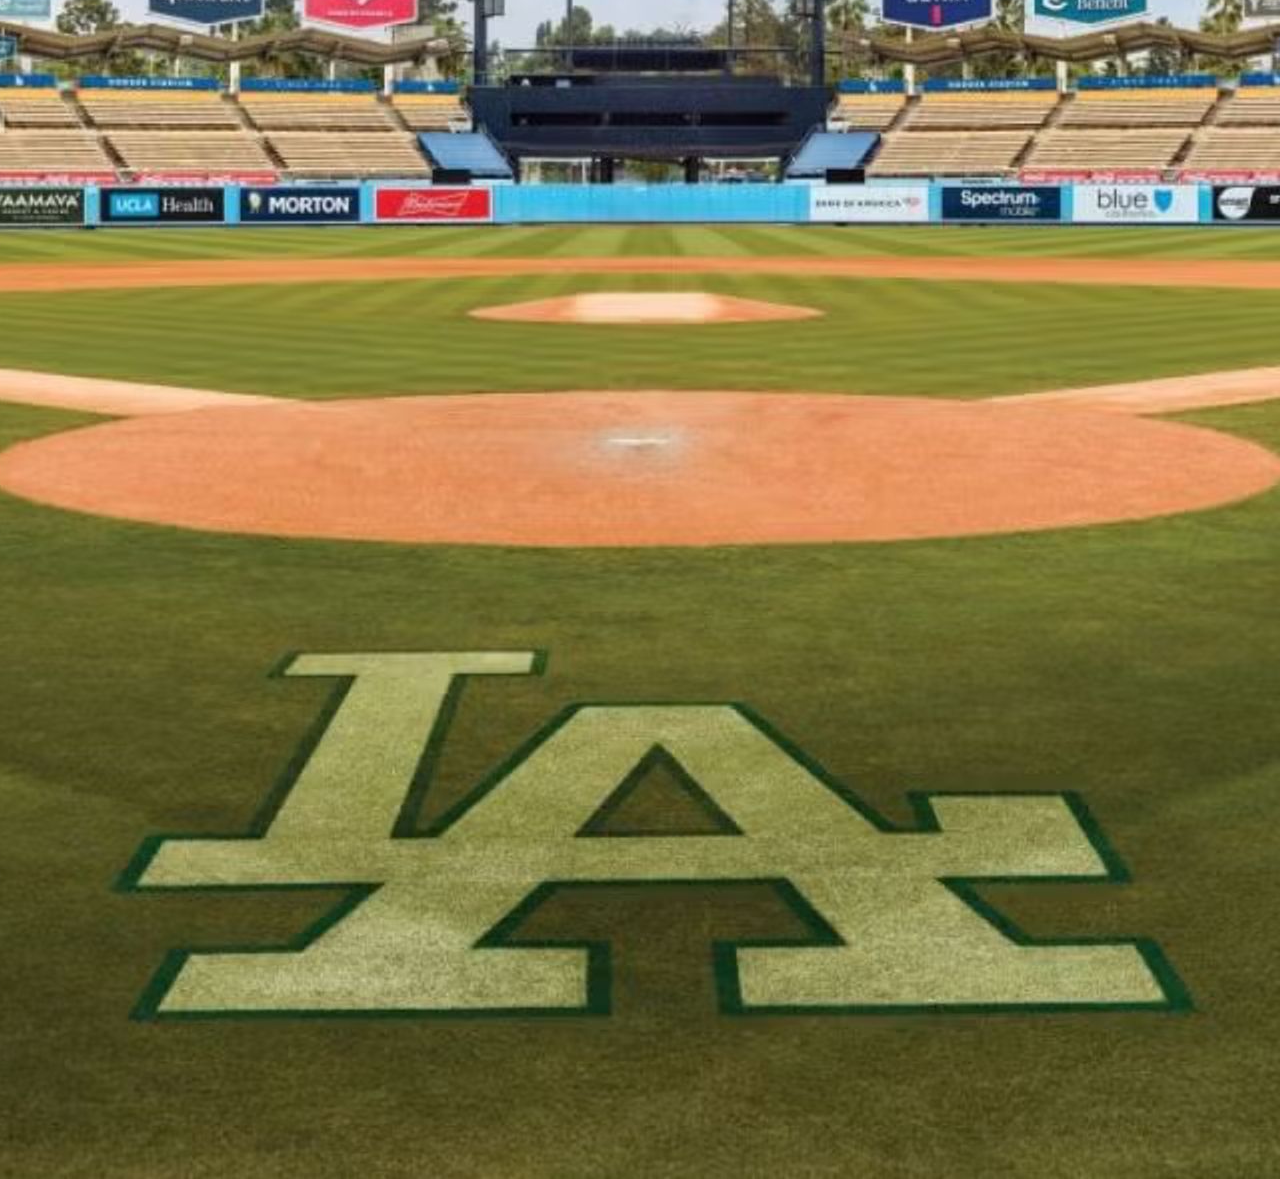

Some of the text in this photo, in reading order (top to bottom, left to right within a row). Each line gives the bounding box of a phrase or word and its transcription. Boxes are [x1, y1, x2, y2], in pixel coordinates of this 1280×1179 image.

[116, 196, 215, 213] UCLA Health
[269, 196, 351, 213] MORTON
[960, 189, 1038, 206] Spectrum
[1097, 188, 1149, 210] blue
[120, 649, 1190, 1018] LA
